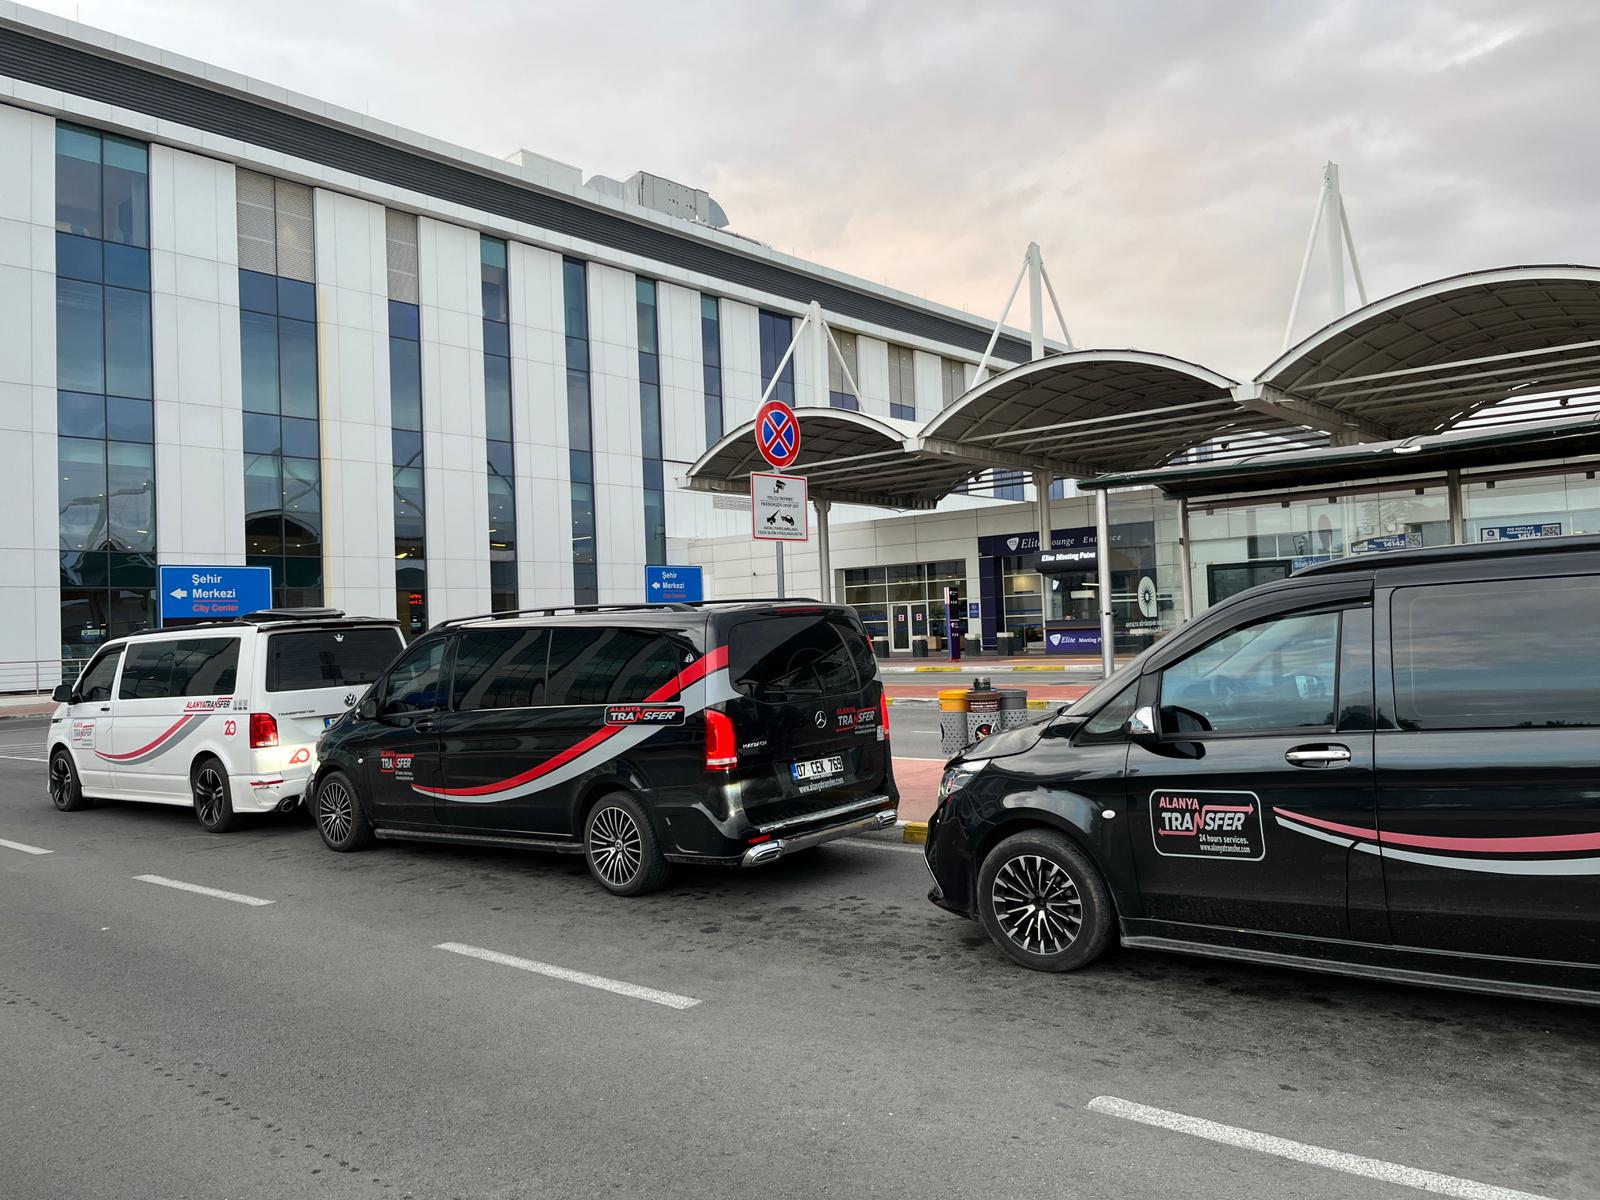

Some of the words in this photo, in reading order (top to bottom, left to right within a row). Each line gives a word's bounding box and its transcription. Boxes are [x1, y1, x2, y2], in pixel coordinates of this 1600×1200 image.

[1052, 538, 1074, 546] ounge
[1056, 553, 1079, 561] Meeting
[192, 574, 222, 586] Şehir
[662, 571, 678, 580] Şehir
[662, 581, 685, 589] Merkezi
[192, 588, 236, 599] Merkezi
[192, 604, 209, 613] City
[211, 603, 239, 612] Center
[1061, 636, 1076, 644] Elite
[610, 711, 676, 721] TRANSFER
[838, 711, 875, 726] TRANSFER
[381, 757, 412, 769] TRANSFER
[796, 763, 806, 777] 07
[828, 757, 842, 771] 769
[1159, 797, 1199, 809] ALANYA
[1161, 812, 1245, 831] TRANSFER
[1199, 834, 1206, 842] 24
[1207, 834, 1222, 843] hours
